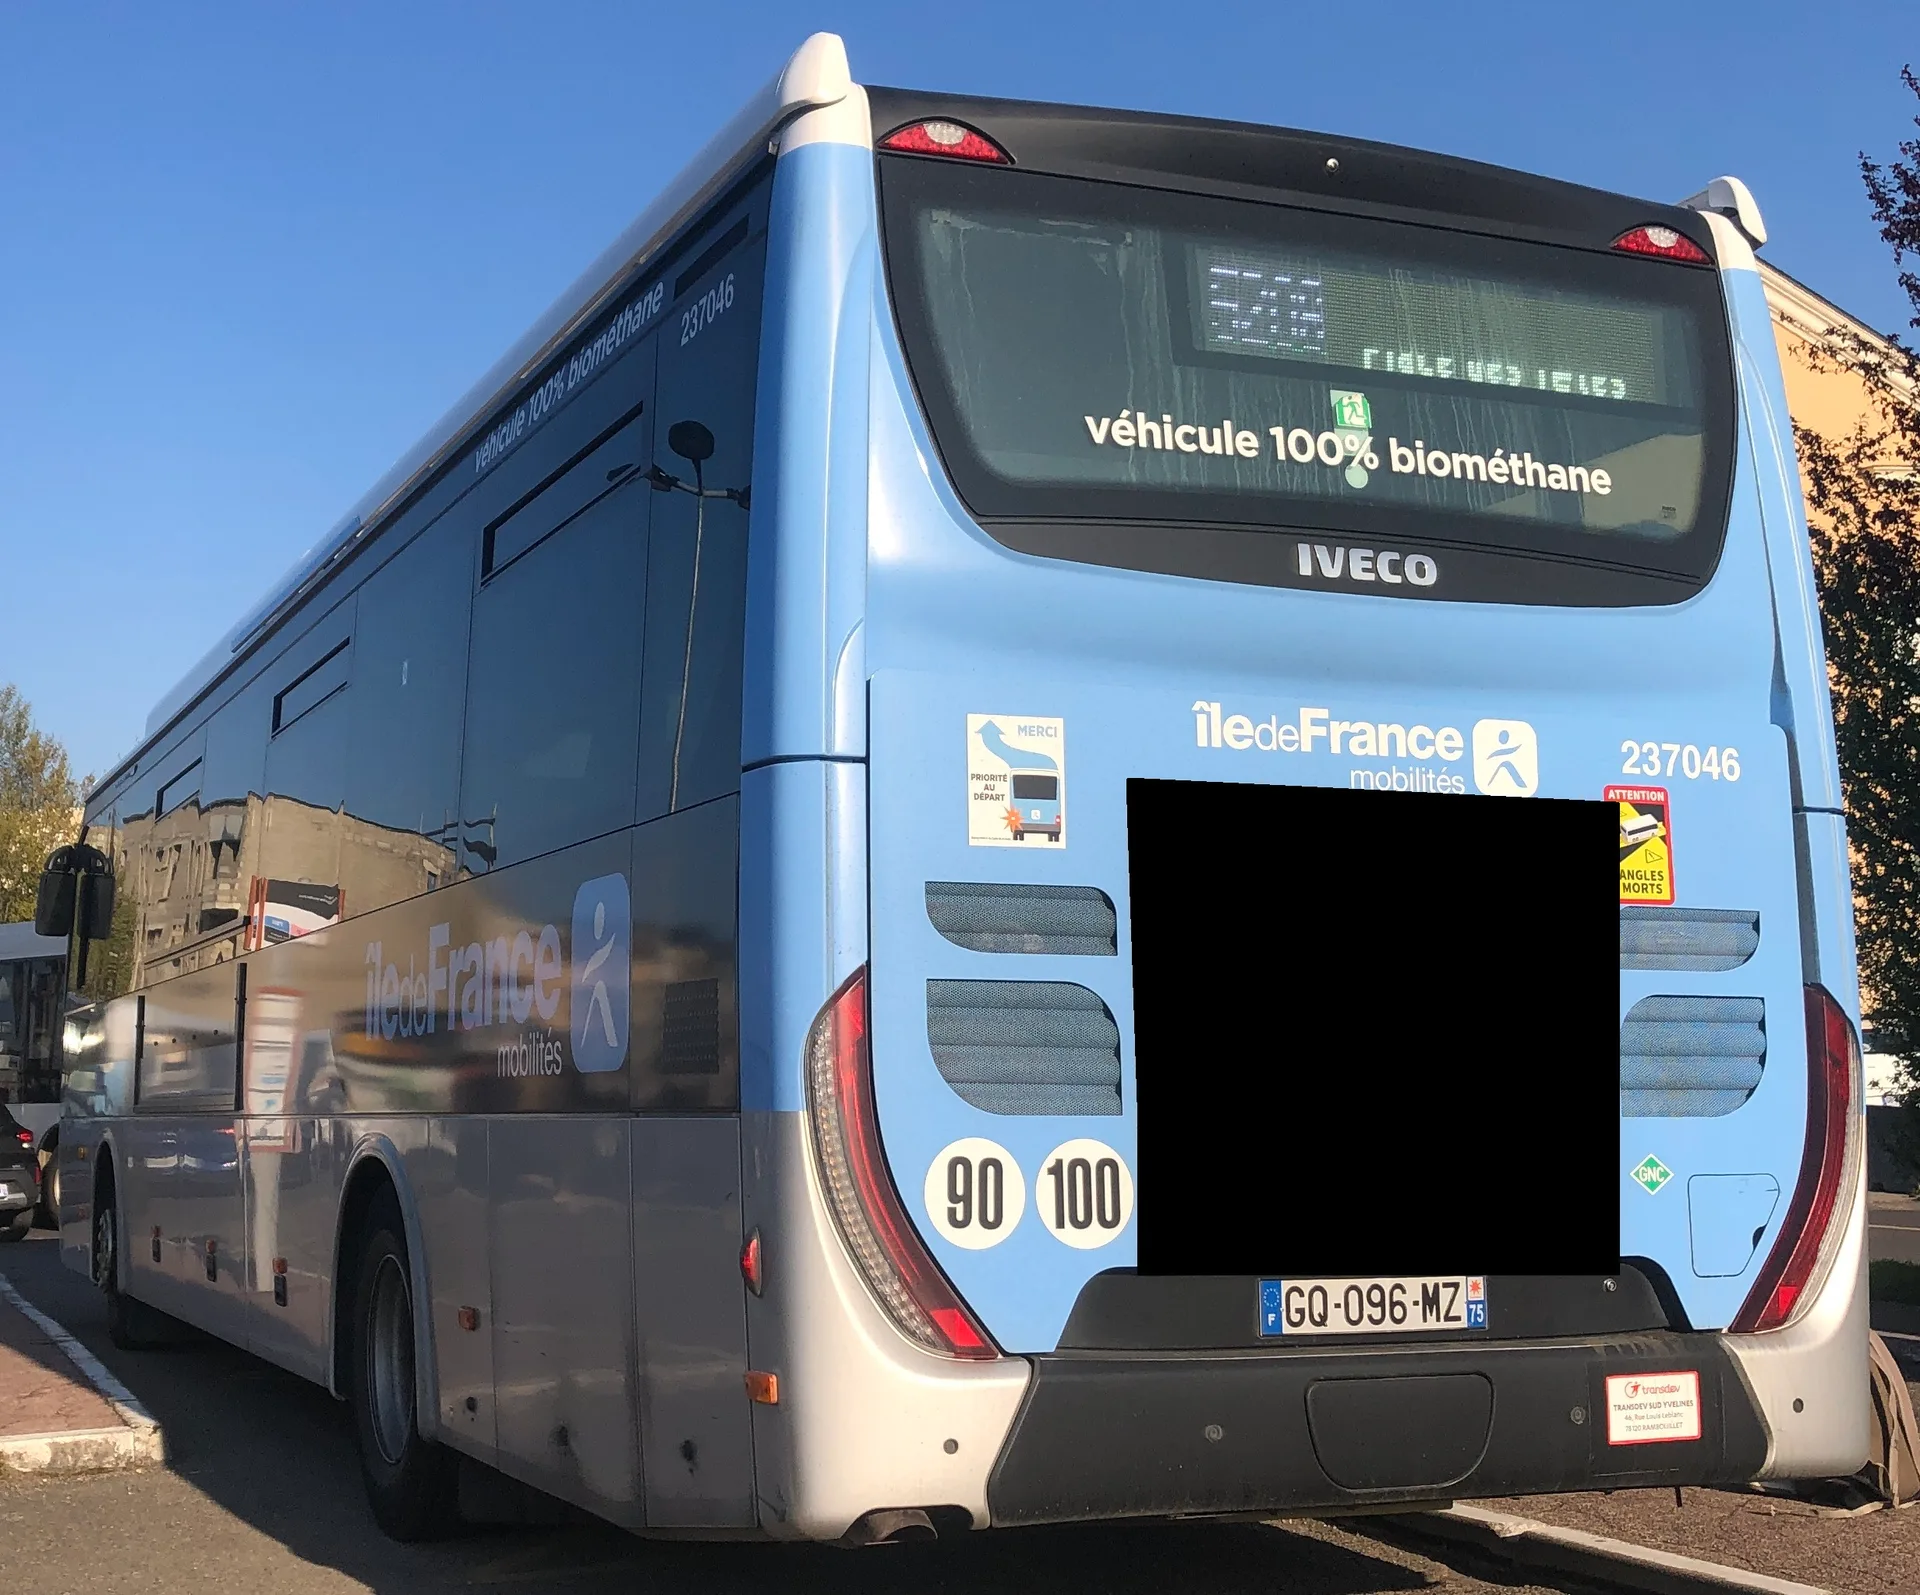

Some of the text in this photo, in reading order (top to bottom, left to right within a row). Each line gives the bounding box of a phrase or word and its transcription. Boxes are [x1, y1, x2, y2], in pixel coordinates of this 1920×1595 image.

[680, 273, 734, 347] 237046
[475, 281, 664, 473] véhicule 100% biométhane
[1084, 409, 1613, 495] véhicule 100% biométhane
[1297, 543, 1438, 587] IVECO
[1017, 724, 1058, 738] MERCI
[1620, 740, 1741, 782] 237046
[970, 773, 1008, 783] PRIORITÉ
[983, 783, 996, 792] AU
[1350, 765, 1466, 795] mobilités
[973, 792, 1005, 802] DÉPART
[1608, 789, 1665, 802] ATTENTION
[1620, 869, 1664, 882] ANGLES
[1622, 882, 1663, 894] MORTS
[497, 1026, 562, 1078] mobilités
[1639, 1166, 1665, 1183] GNC
[947, 1156, 1004, 1230] 90
[1046, 1157, 1121, 1230] 100
[1267, 1281, 1484, 1328] F GQ-096-MZ 75
[1642, 1384, 1681, 1395] transdev
[1613, 1400, 1694, 1412] TRANSDEV SUD YVELINES
